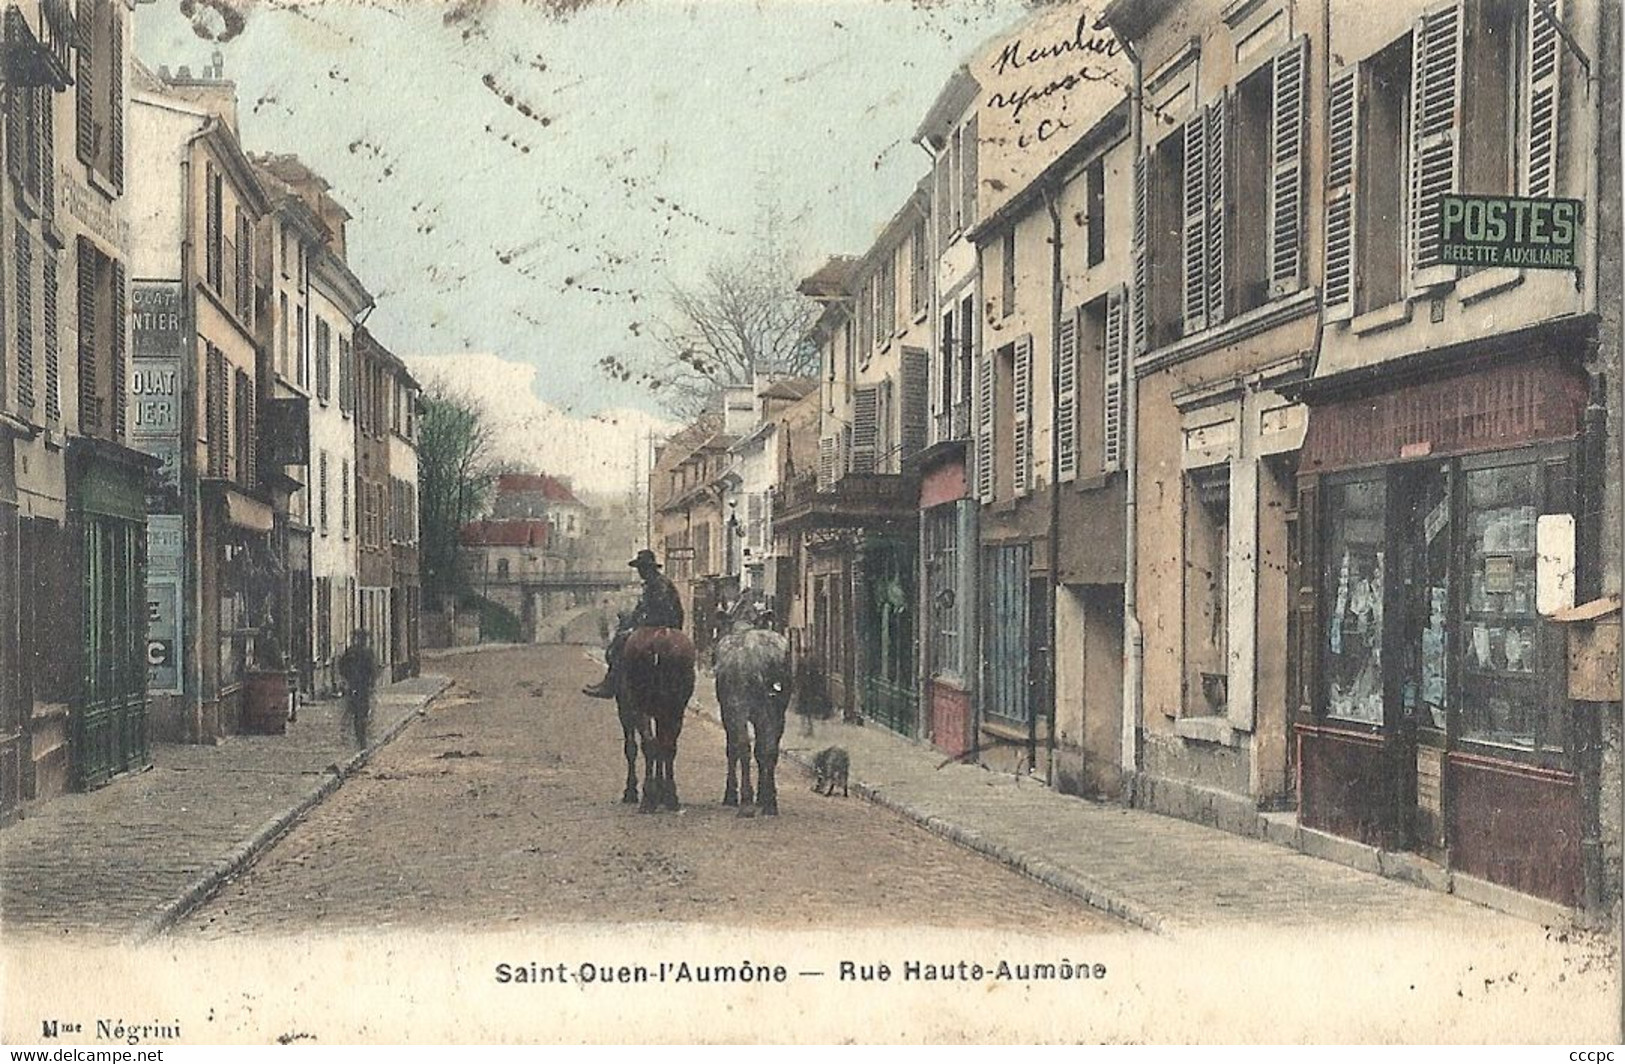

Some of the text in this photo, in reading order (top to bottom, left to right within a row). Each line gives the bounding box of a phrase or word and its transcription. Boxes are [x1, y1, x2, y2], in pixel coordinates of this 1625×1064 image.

[1442, 200, 1574, 245] POSTES
[1442, 244, 1573, 266] RECETTE AUXILIAIRE
